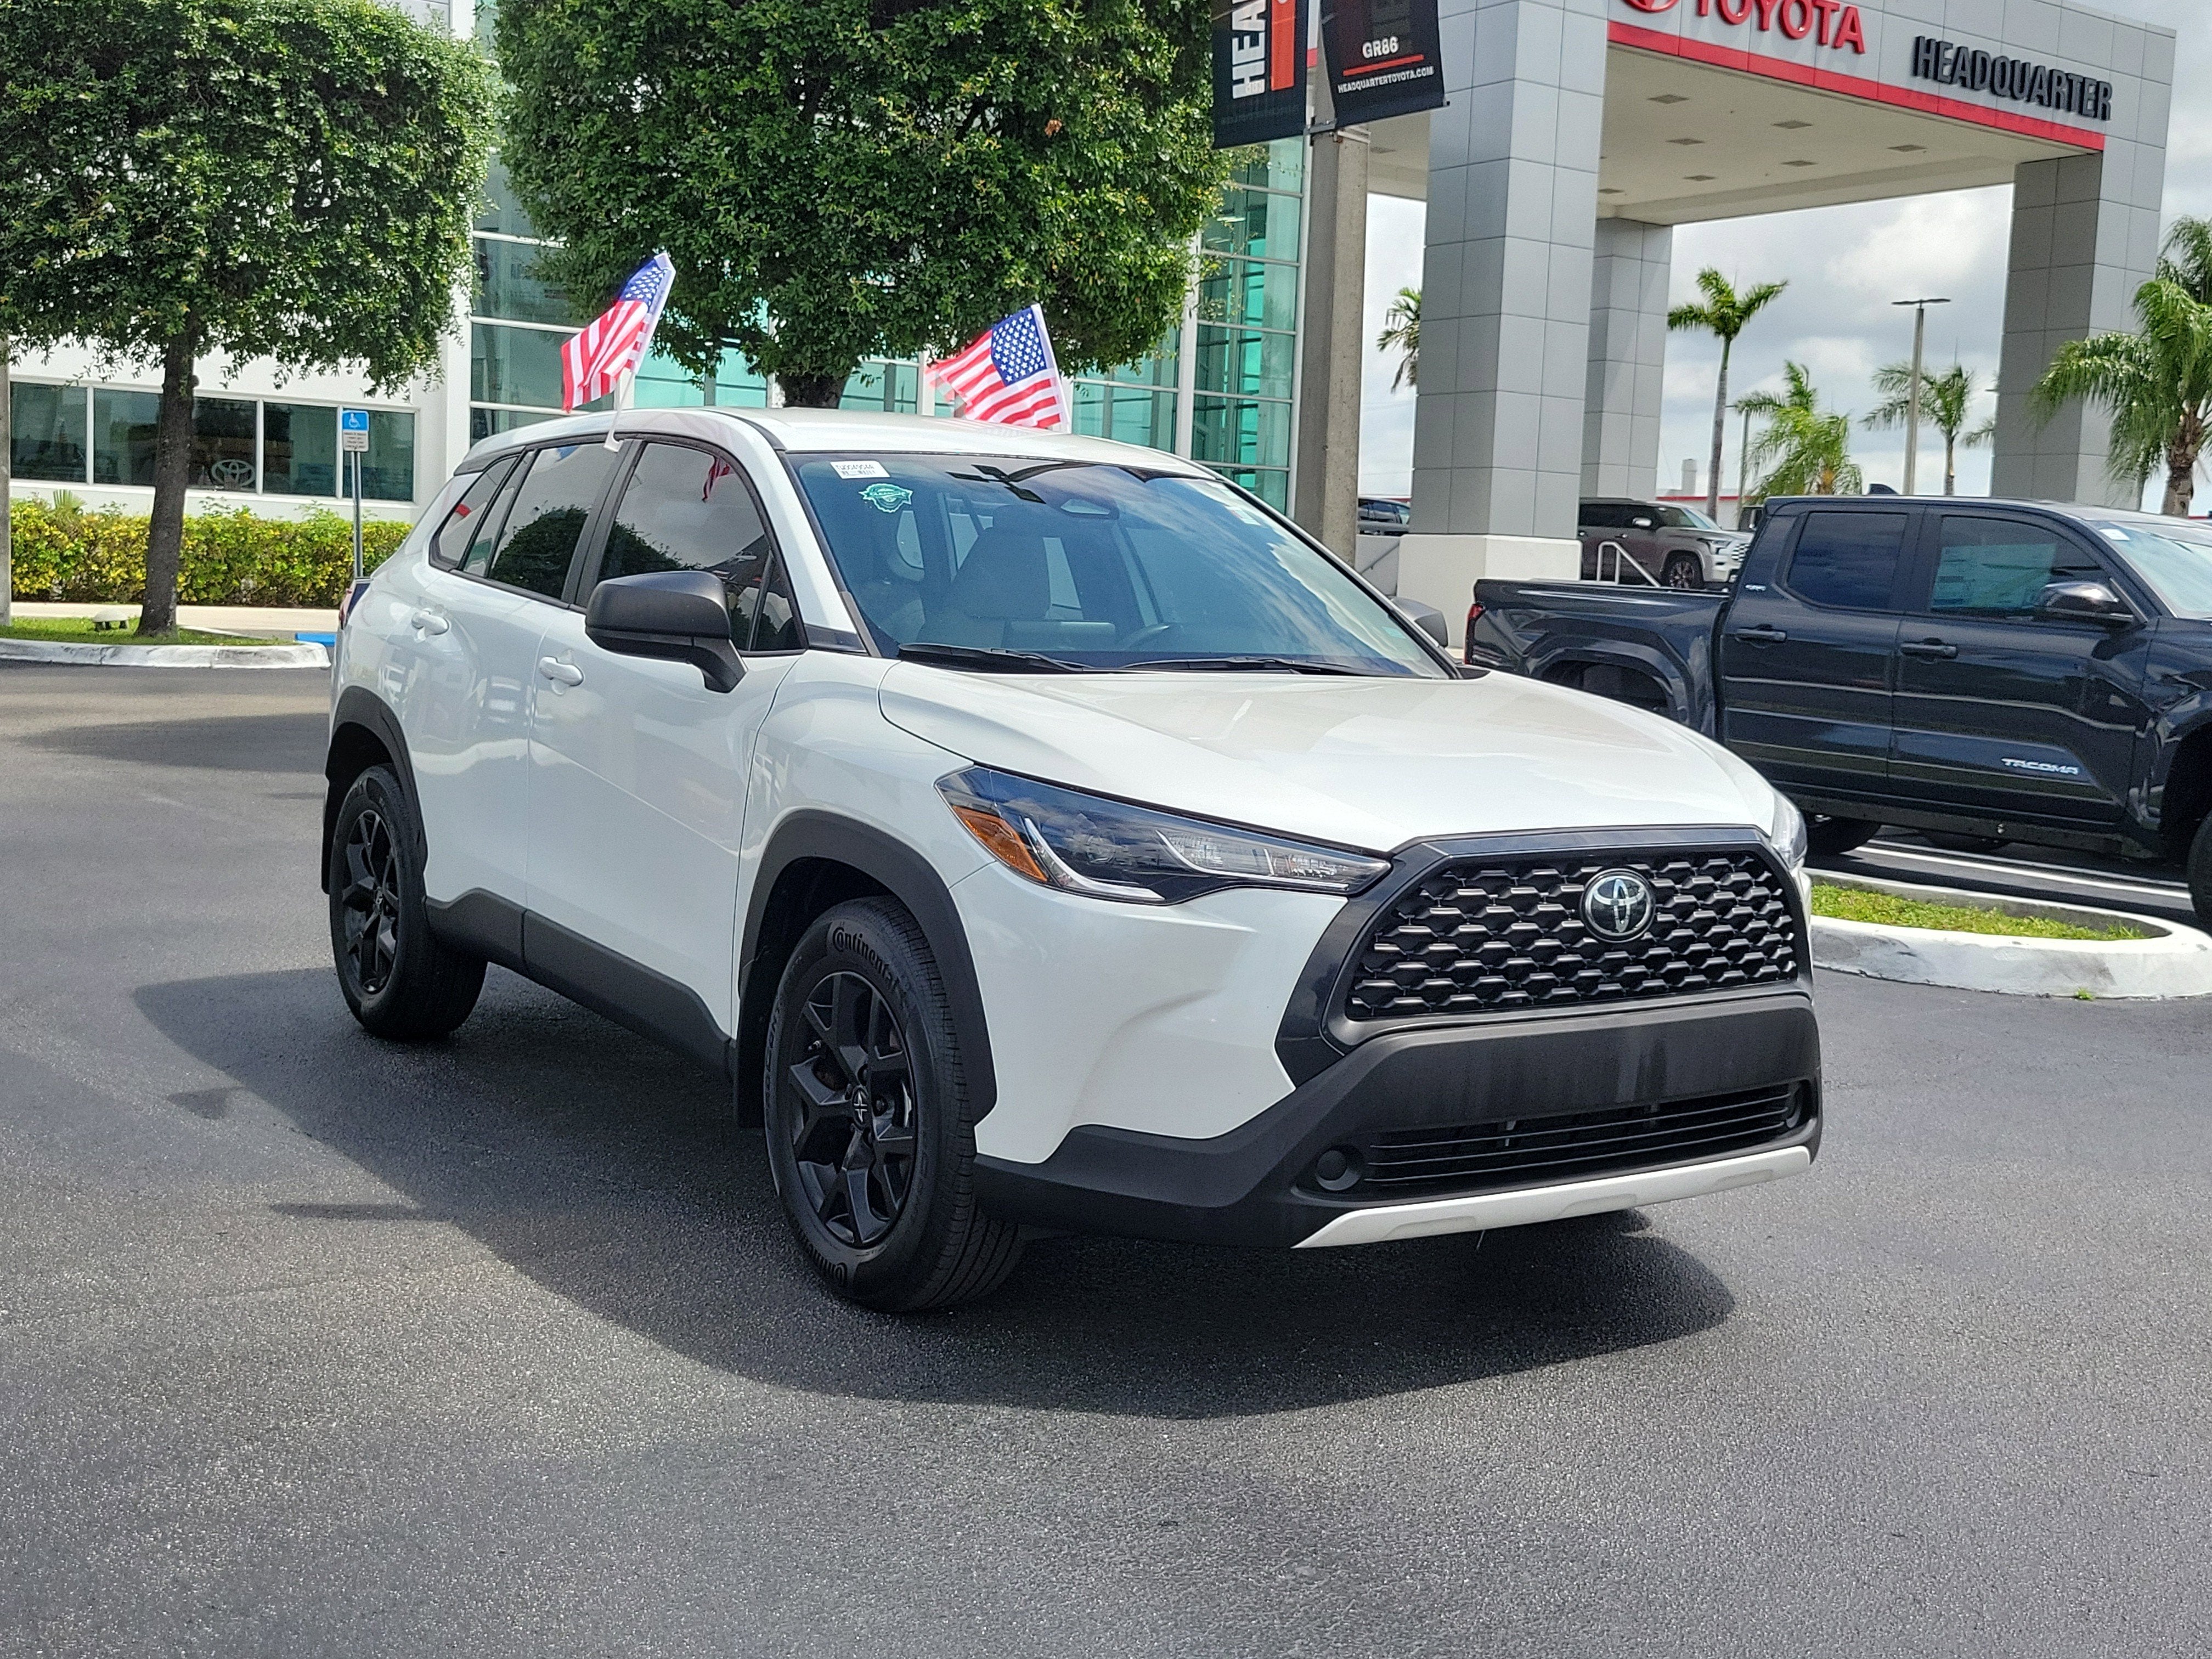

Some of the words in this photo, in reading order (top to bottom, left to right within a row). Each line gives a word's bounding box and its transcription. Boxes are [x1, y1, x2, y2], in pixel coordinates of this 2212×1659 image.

[1232, 0, 1266, 99] HEA
[1362, 36, 1398, 59] GR86
[1338, 66, 1435, 93] HEADQUARTERTOYOTA.COM
[1912, 36, 2113, 121] HEADQUARTER
[2001, 758, 2078, 775] TACOMA
